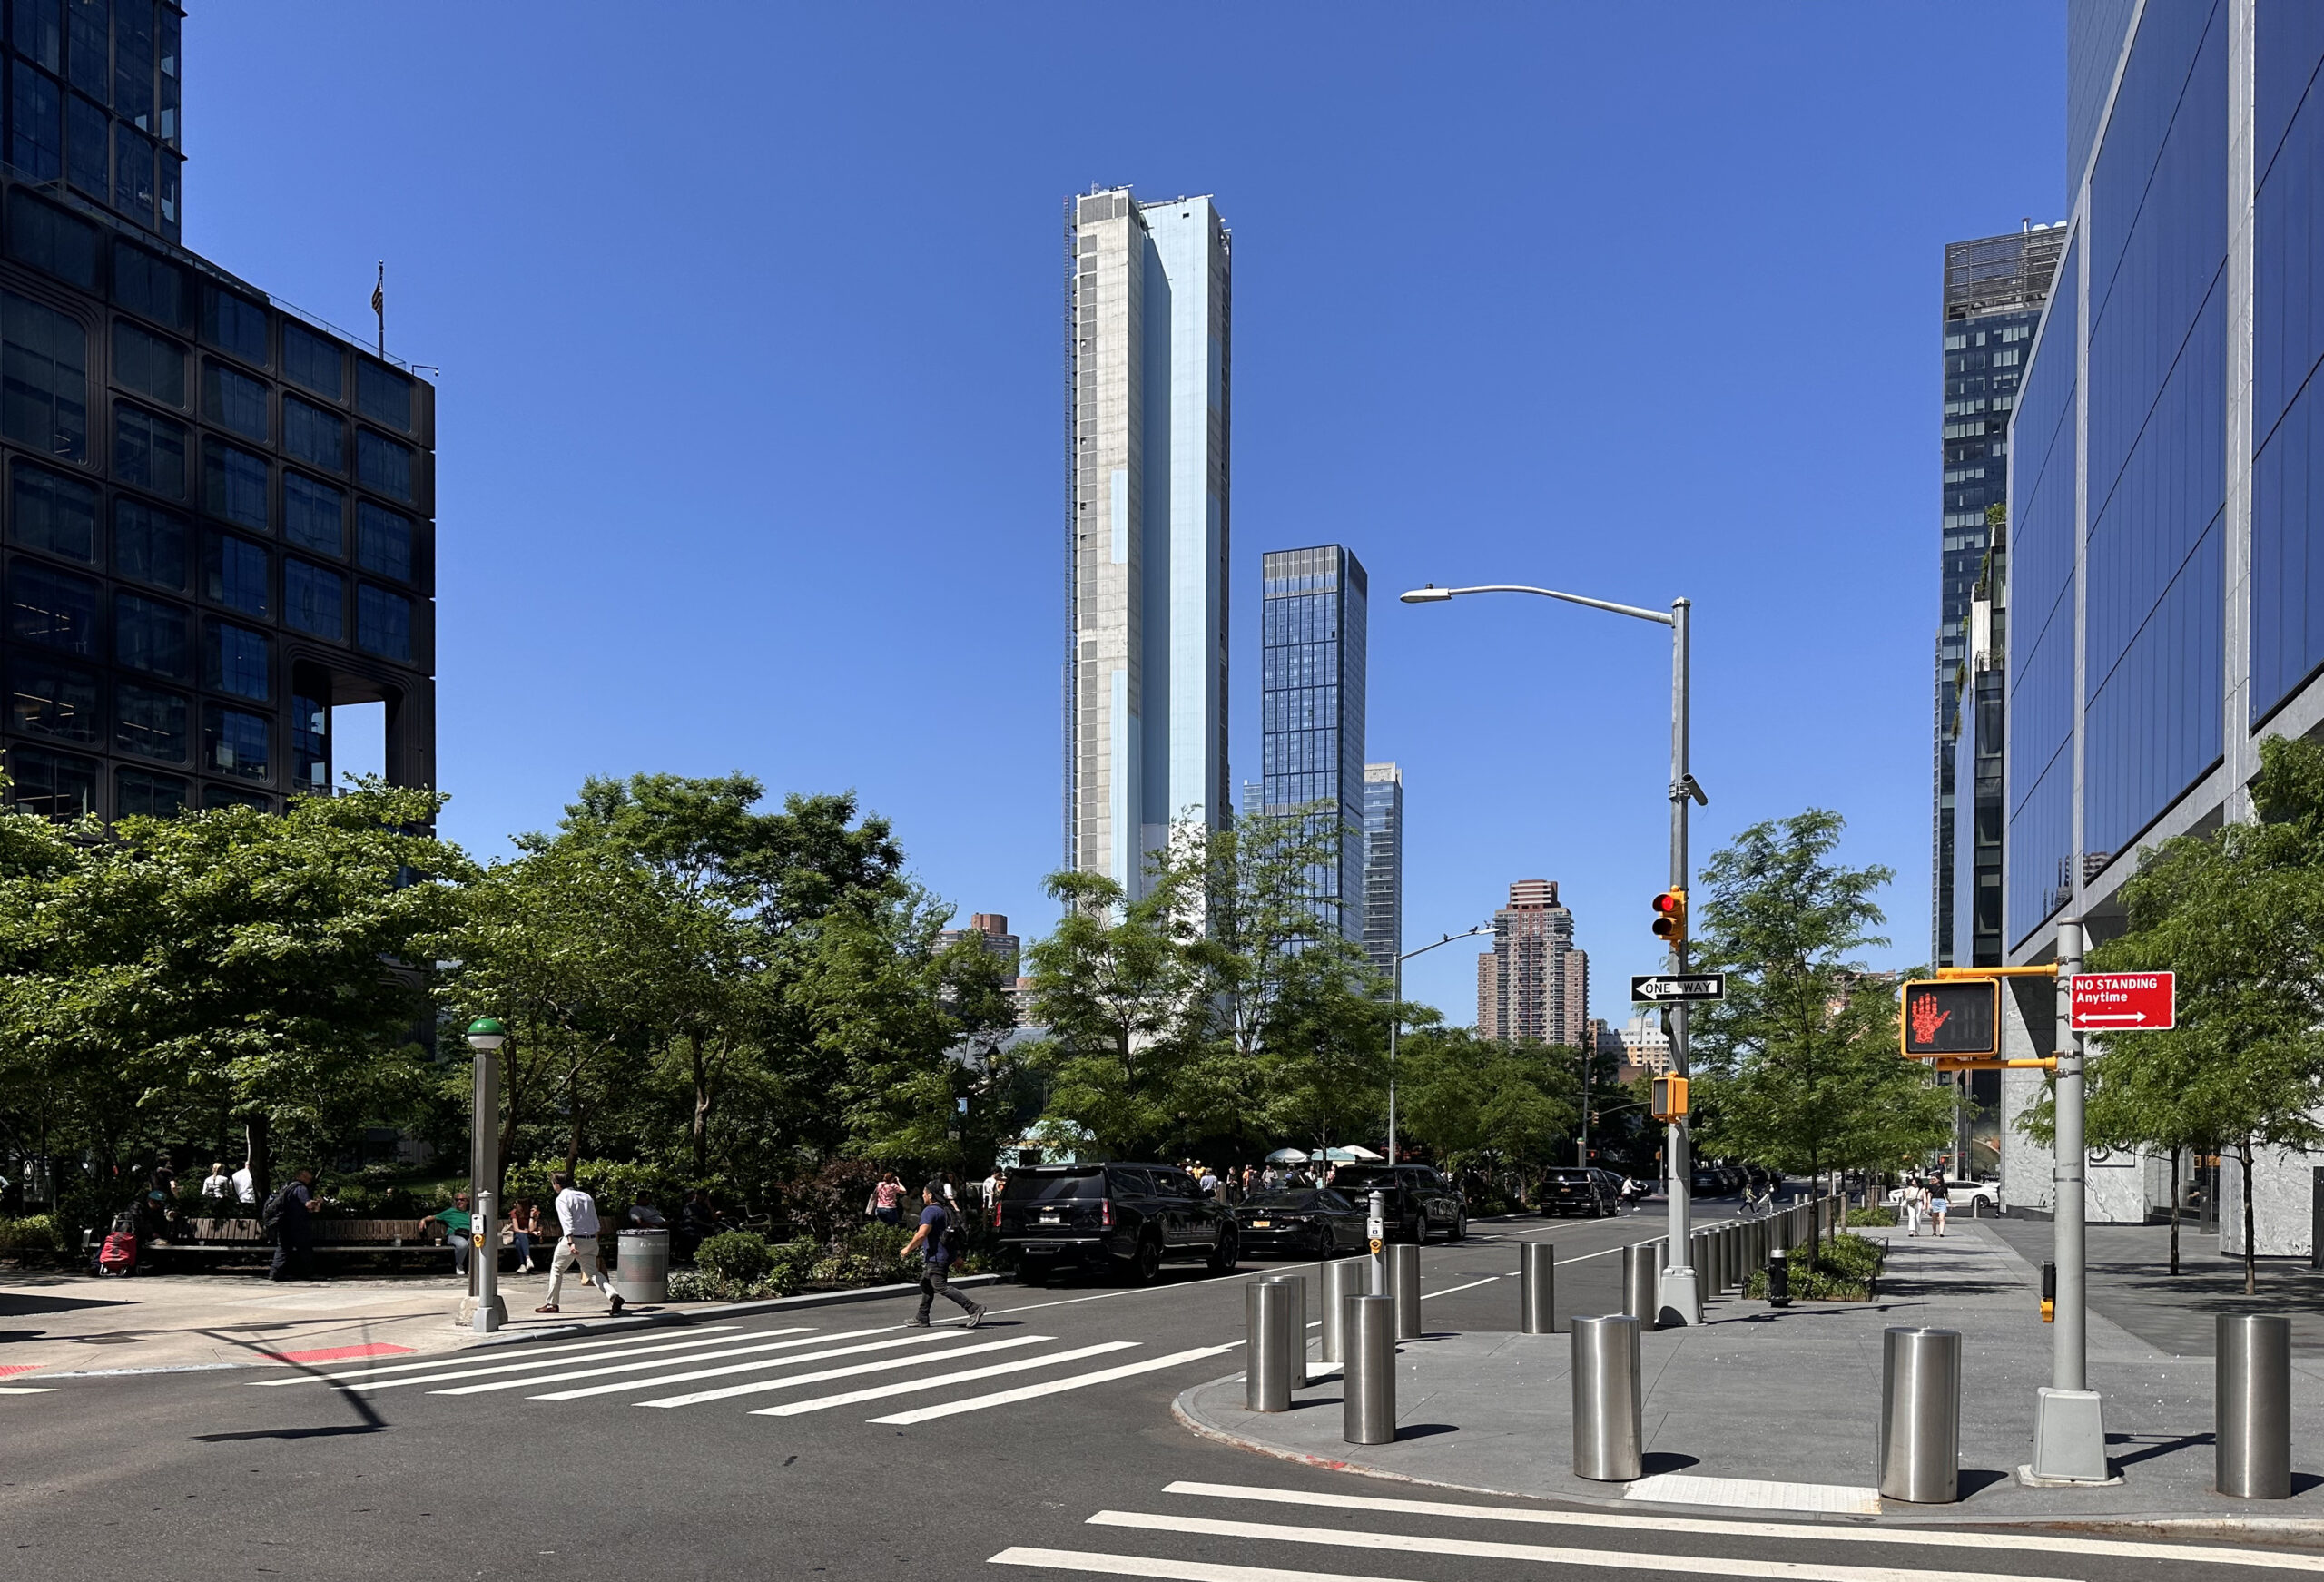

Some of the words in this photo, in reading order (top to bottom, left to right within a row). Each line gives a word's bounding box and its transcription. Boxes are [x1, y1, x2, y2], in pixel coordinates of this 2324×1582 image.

[1645, 983, 1671, 994] ONE
[1683, 982, 1712, 993] WAY
[2076, 979, 2093, 990] NO
[2096, 978, 2158, 990] STANDING
[2076, 992, 2128, 1005] Anytime
